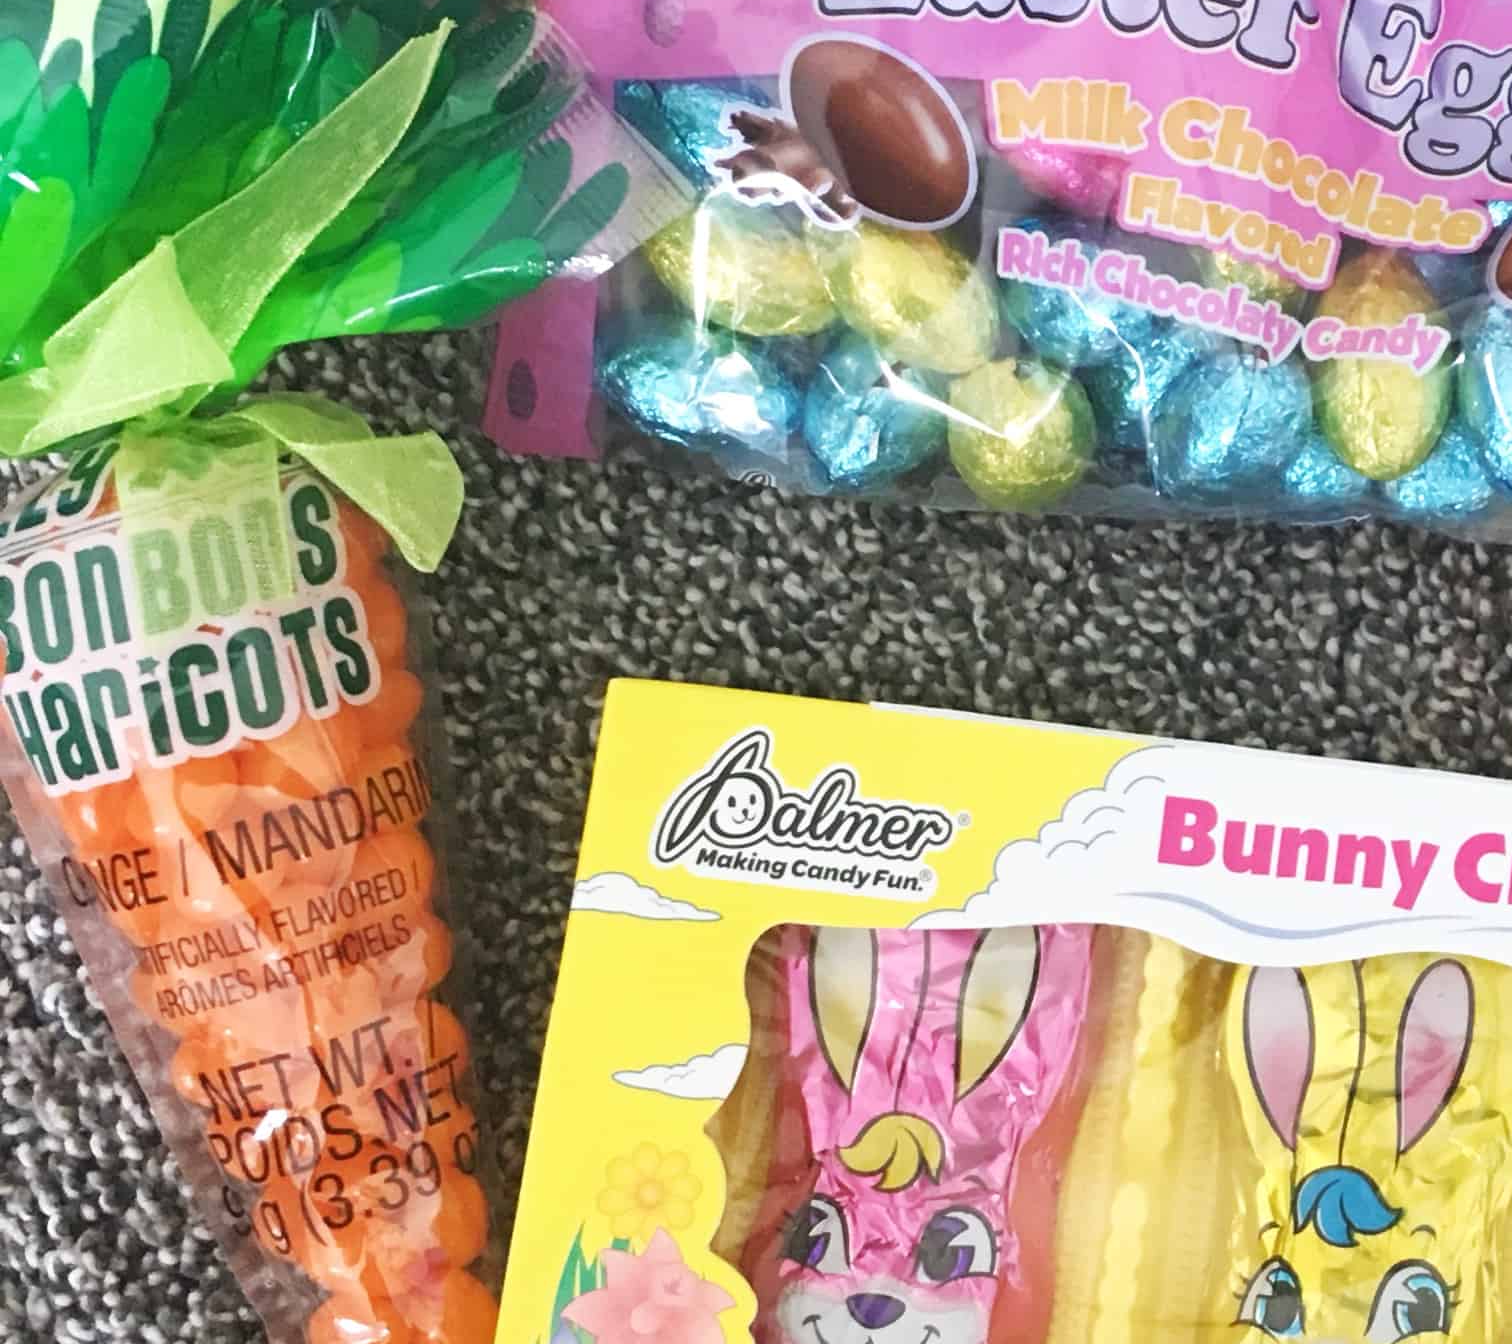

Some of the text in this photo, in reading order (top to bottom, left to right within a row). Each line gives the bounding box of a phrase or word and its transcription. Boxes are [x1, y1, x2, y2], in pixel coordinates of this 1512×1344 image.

[993, 80, 1487, 248] Milk Chocolate
[1002, 231, 1446, 371] Rich Chocolaty Candy
[656, 730, 953, 863] Palmer
[1157, 796, 1440, 910] Bunny
[272, 866, 407, 940] FLAVORED
[696, 849, 787, 879] Making
[791, 859, 871, 889] Candy
[264, 913, 412, 993] ARTIFICIELS
[199, 1052, 294, 1125] NET
[309, 1015, 415, 1098] WT.
[208, 1052, 463, 1183] POIDS NET
